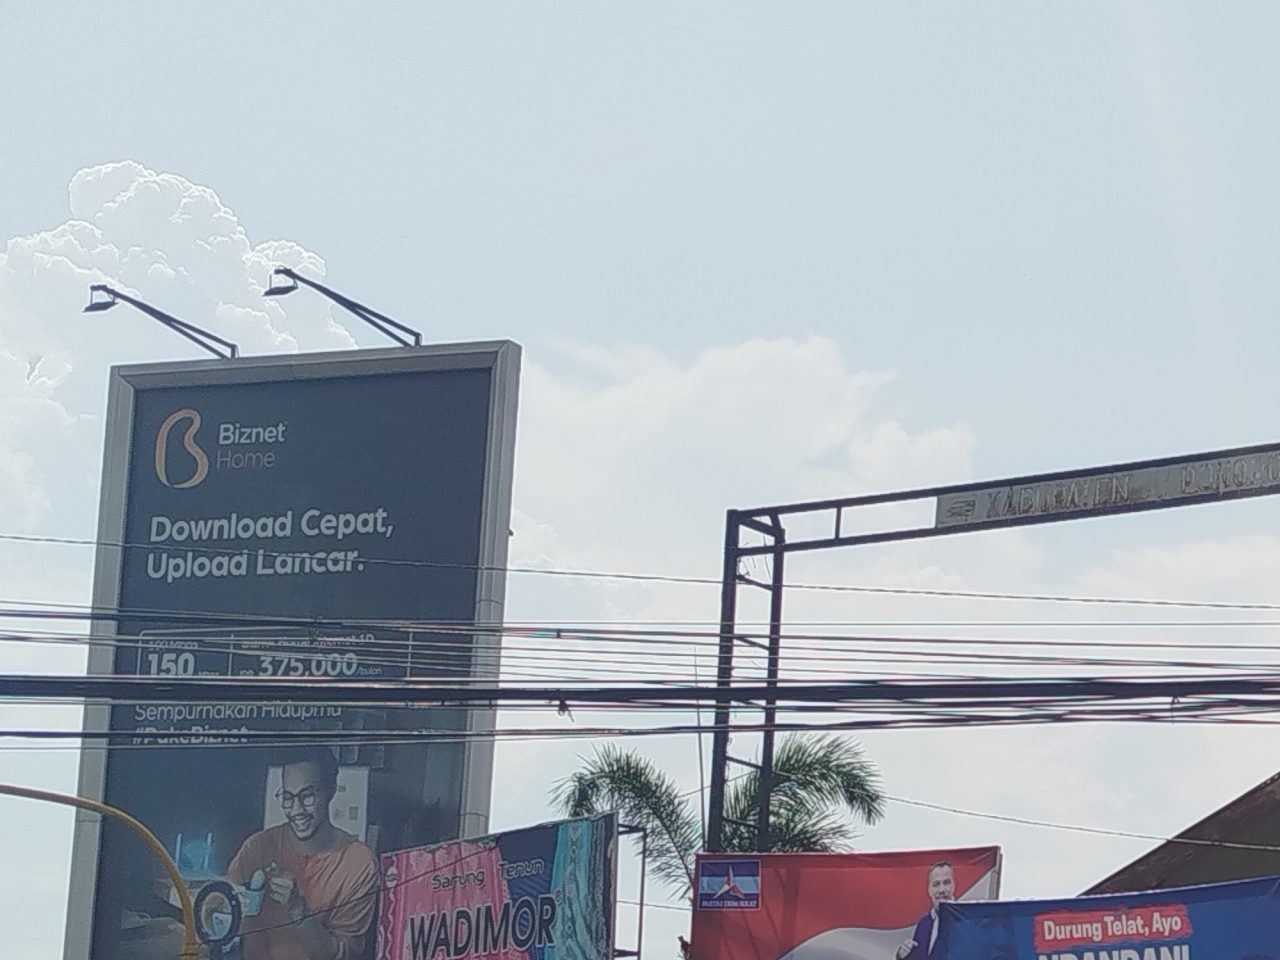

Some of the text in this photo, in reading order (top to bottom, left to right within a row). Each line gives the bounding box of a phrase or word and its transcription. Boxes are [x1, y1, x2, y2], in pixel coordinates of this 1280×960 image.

[218, 422, 286, 445] Biznet
[217, 451, 275, 469] Home
[150, 508, 395, 542] Download Cepat,
[147, 548, 365, 583] Upload Lancar.
[148, 652, 195, 676] 150
[259, 653, 358, 677] 375,000
[431, 858, 545, 891] Sarung Tenun
[1043, 912, 1182, 942] Durung Telat, Ayo
